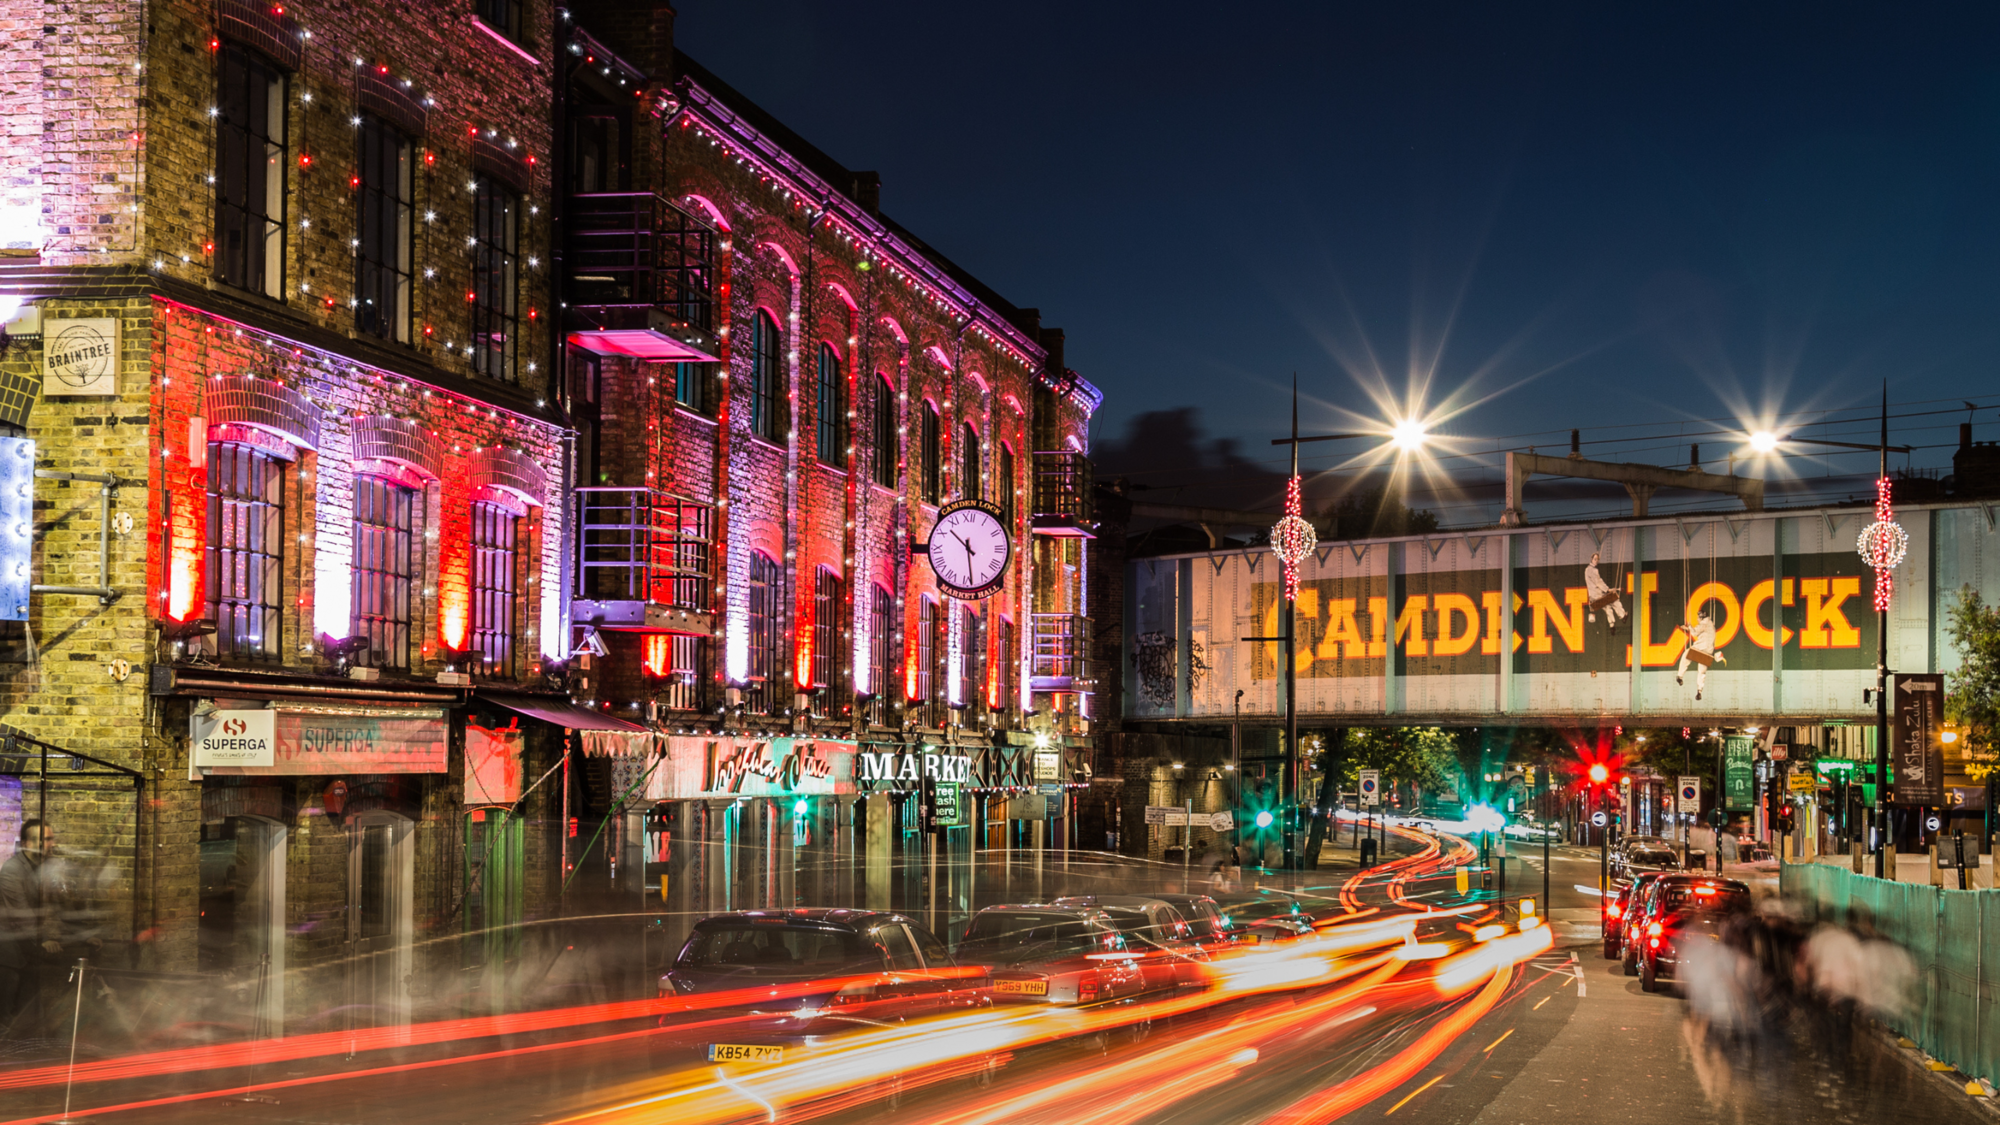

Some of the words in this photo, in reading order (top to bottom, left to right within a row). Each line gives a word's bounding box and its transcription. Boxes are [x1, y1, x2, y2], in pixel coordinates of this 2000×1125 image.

[48, 343, 111, 369] BRAINTREE
[941, 500, 977, 516] CAMDEN
[978, 500, 1002, 517] LOCK
[940, 584, 976, 599] MARKET
[977, 585, 1000, 599] HALL
[1264, 588, 1588, 675] CAMDEN
[1626, 571, 1862, 668] LOCK
[1903, 700, 1920, 728] Zulu
[203, 738, 267, 751] SUPERGA
[304, 726, 374, 753] SUPERGA
[1904, 730, 1921, 764] Shaka
[1728, 744, 1750, 752] FISH
[1772, 747, 1786, 759] illy
[701, 741, 785, 793] Irregular
[780, 743, 832, 792] Choice
[936, 785, 954, 796] ree
[936, 795, 956, 806] ash
[1024, 982, 1044, 993] YHH
[716, 1046, 751, 1060] KB54
[754, 1047, 781, 1061] ZYZ
